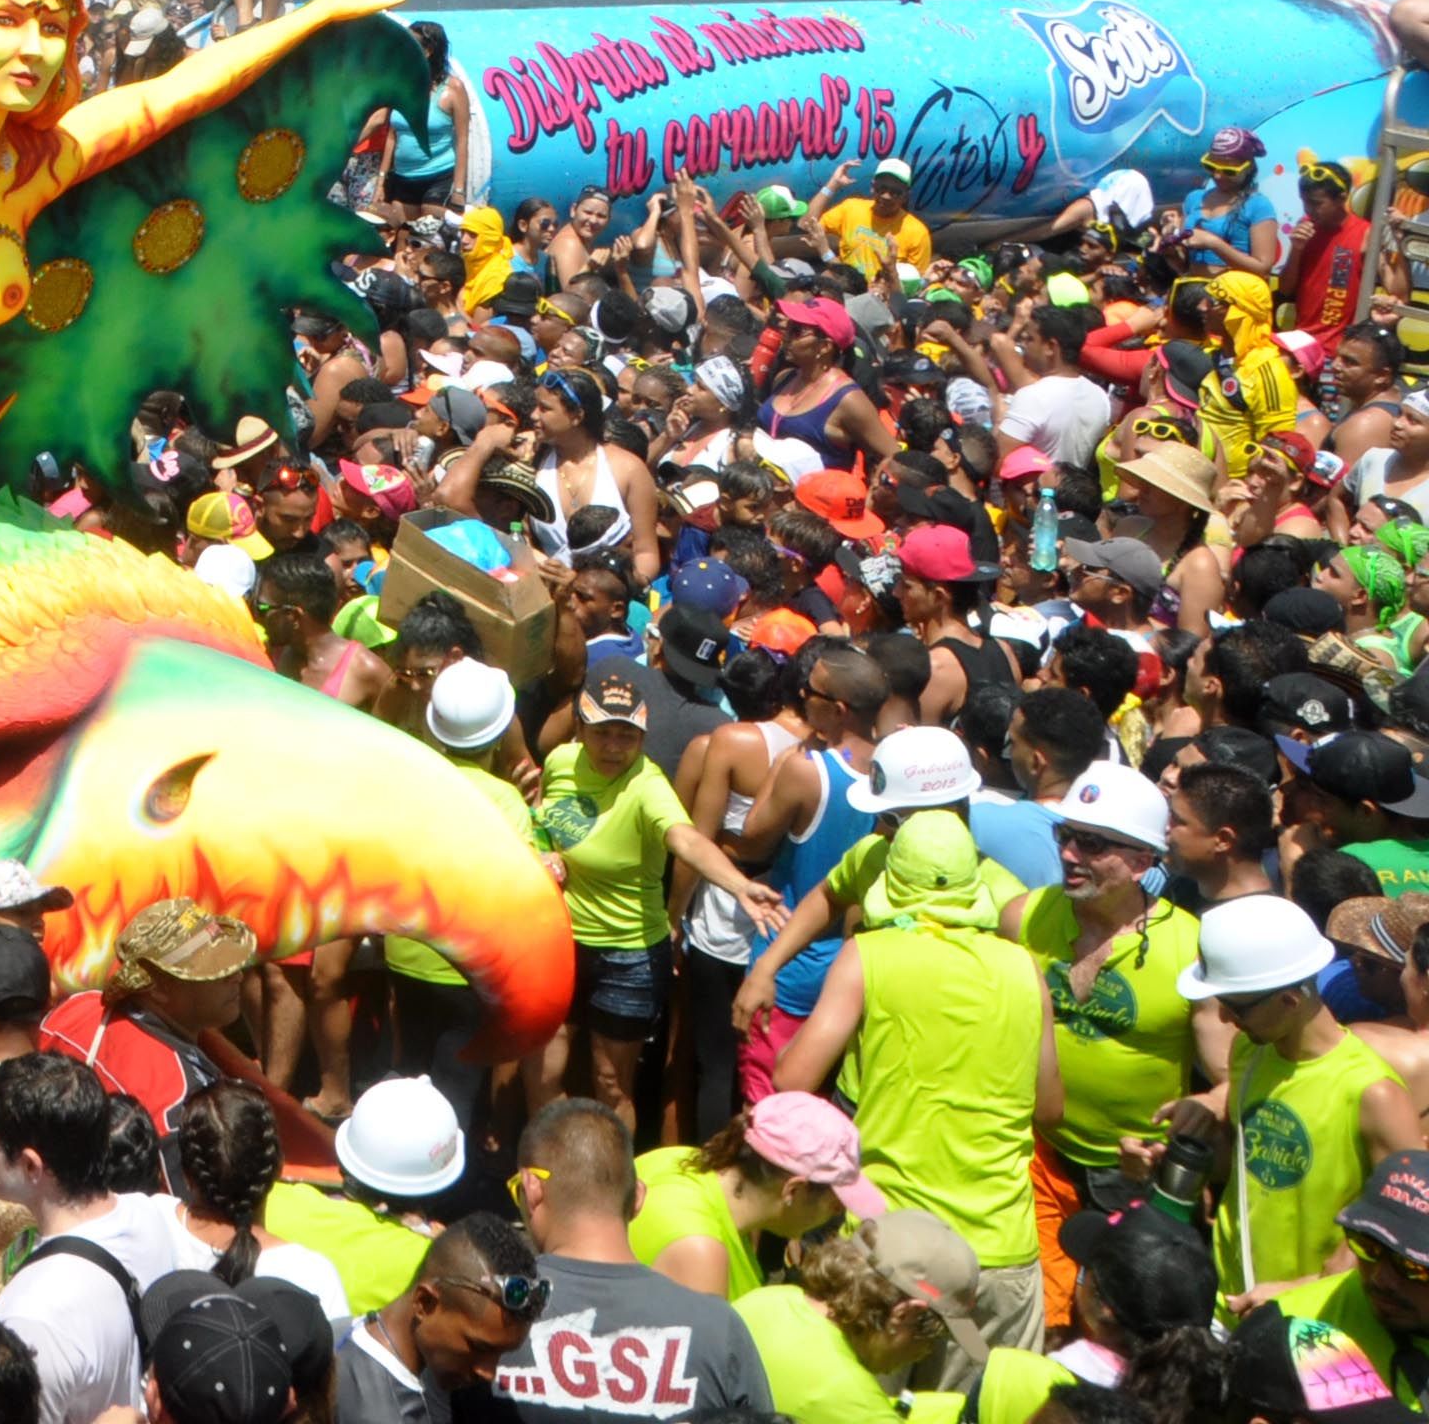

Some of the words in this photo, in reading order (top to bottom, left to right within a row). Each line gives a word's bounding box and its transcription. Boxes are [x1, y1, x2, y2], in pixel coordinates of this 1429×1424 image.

[483, 33, 668, 153] Disfruta
[651, 14, 714, 78] al
[1045, 5, 1178, 125] Scott
[605, 118, 655, 198] tu
[1015, 112, 1048, 196] y
[920, 778, 958, 792] 2015
